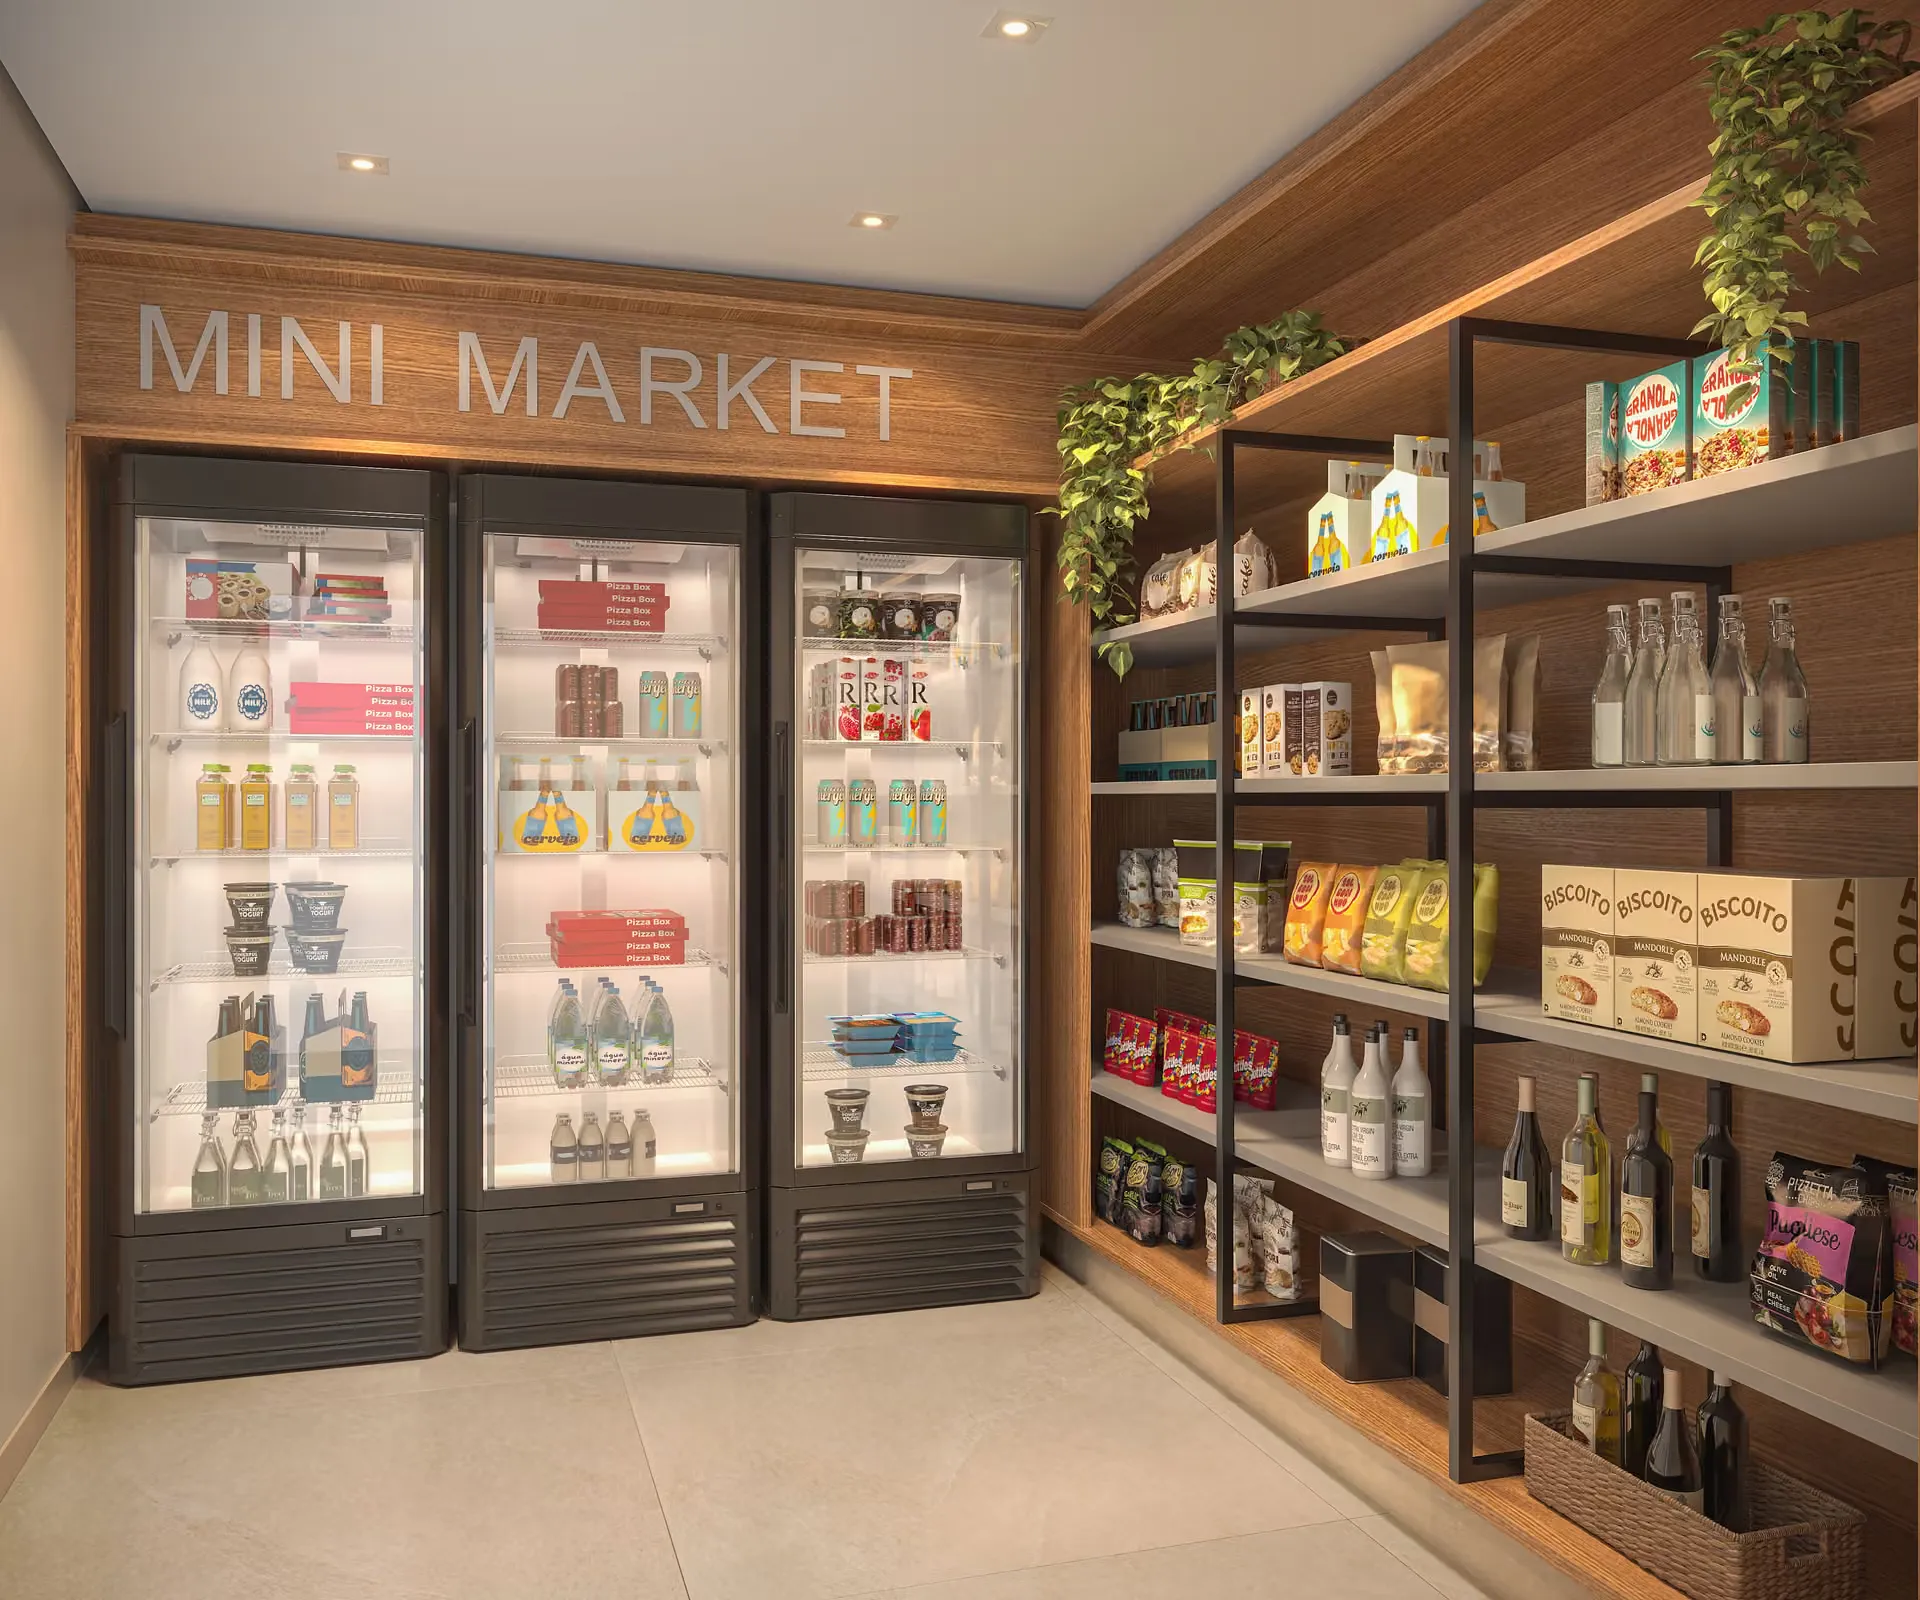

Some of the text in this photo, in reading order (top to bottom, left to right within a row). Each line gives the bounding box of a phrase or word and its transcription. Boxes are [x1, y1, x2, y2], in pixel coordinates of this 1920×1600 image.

[139, 304, 914, 441] MINI MARKET
[1626, 384, 1676, 416] GRANOLA
[1626, 409, 1678, 441] GRANOLA
[366, 684, 392, 692] Pizza
[840, 682, 856, 704] R
[864, 682, 880, 703] R
[884, 684, 900, 706] R
[912, 682, 928, 704] R
[244, 698, 261, 706] MILK
[366, 710, 392, 718] Pizza
[522, 832, 580, 846] cerveja
[630, 832, 687, 845] cerveja
[1544, 884, 1610, 916] BISCOITO
[1616, 890, 1692, 924] BISCOITO
[1700, 896, 1788, 933] BISCOITO
[1558, 933, 1594, 946] MANDORLE
[1634, 942, 1674, 956] MANDORLE
[1720, 952, 1766, 967] MANDORLE
[1720, 1032, 1764, 1046] ALMOND COOKIES
[560, 1054, 582, 1062] água
[604, 1052, 624, 1060] água
[1788, 1176, 1834, 1200] PIZZETTA
[1769, 1210, 1840, 1250] Pugliese
[1768, 1272, 1778, 1280] OIL
[1770, 1264, 1788, 1276] OLIVE
[1768, 1290, 1784, 1302] REAL
[1767, 1298, 1792, 1314] CHEESE
